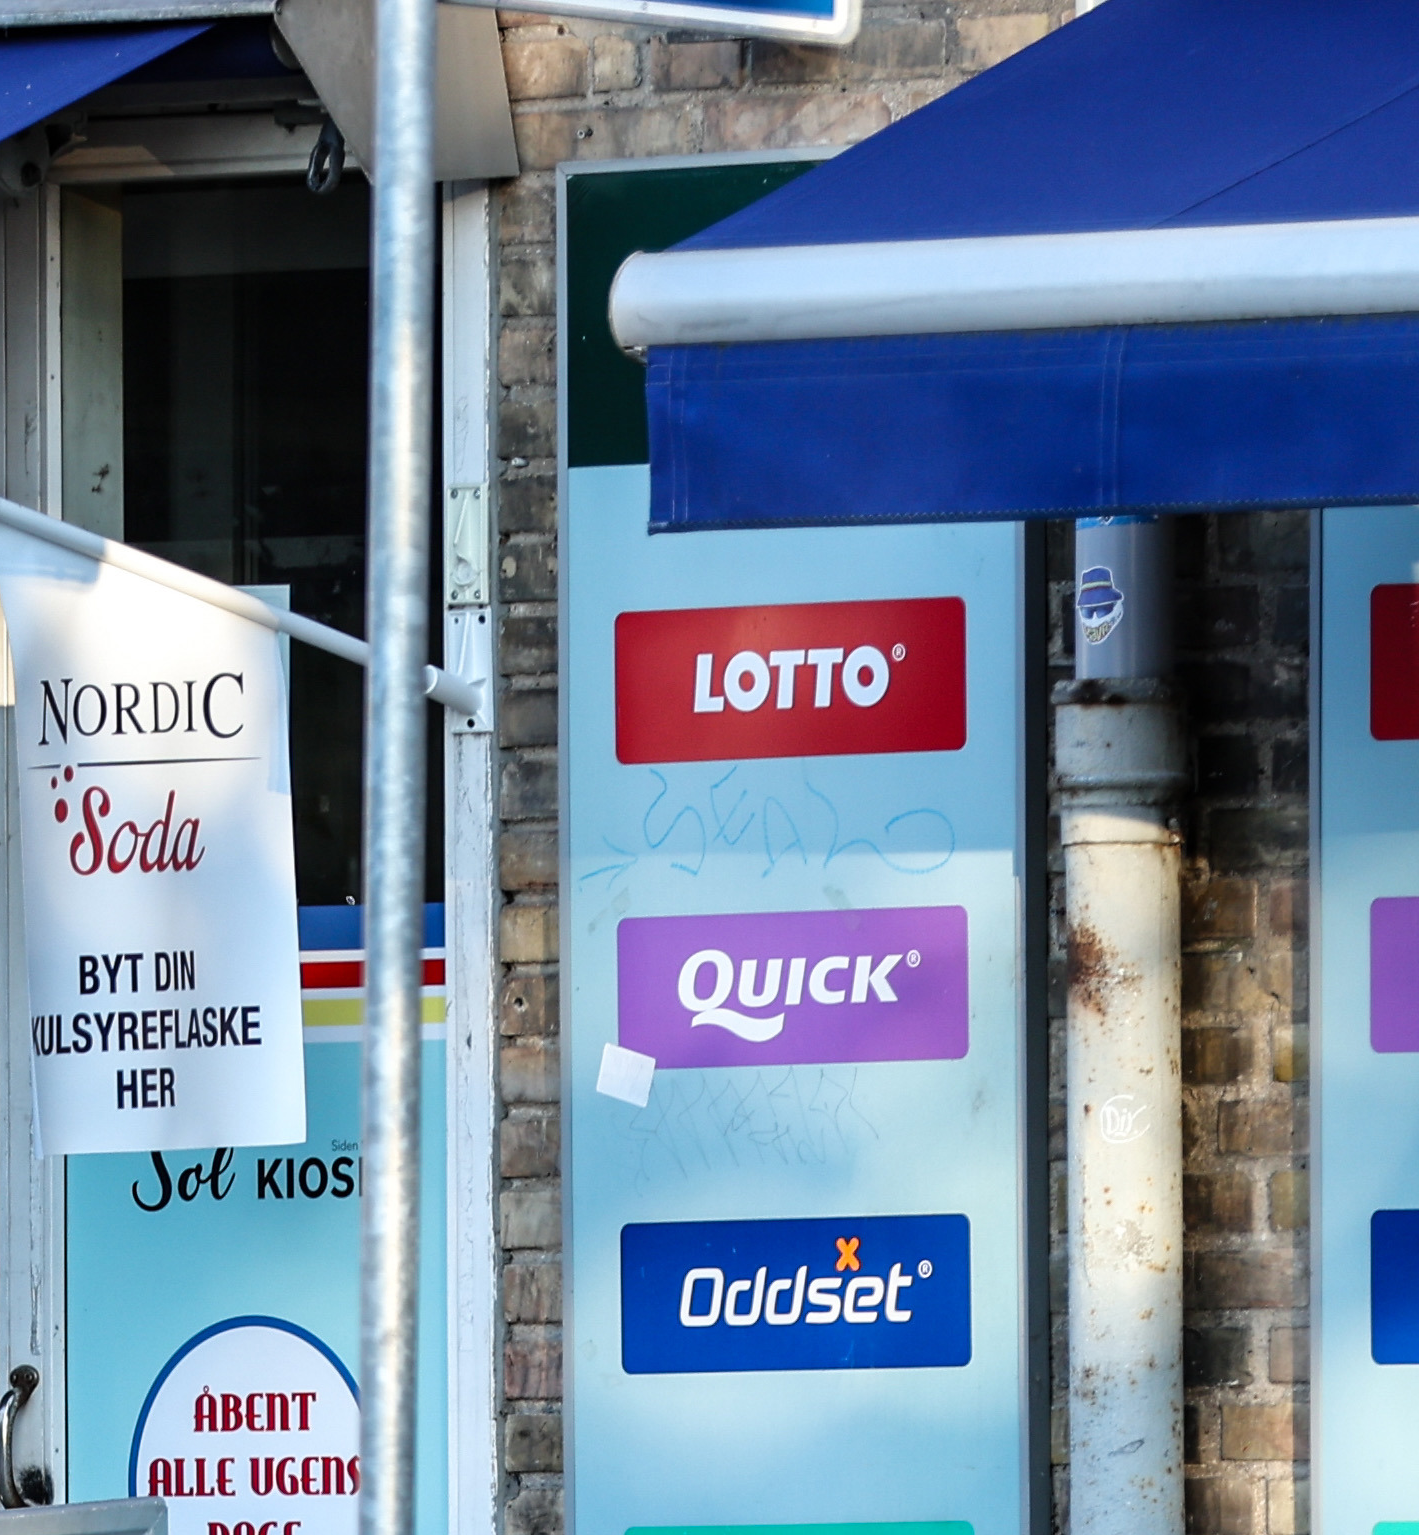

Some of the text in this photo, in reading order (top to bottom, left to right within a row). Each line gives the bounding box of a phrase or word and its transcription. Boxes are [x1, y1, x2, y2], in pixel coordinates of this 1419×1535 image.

[692, 645, 890, 714] LOTTO
[38, 672, 244, 746] NORDIC
[69, 785, 206, 876] Soda
[78, 950, 196, 995] BYT DIN
[31, 1005, 262, 1057] KULSYREFLASKE
[116, 1067, 176, 1110] HER
[331, 1139, 359, 1152] Siden
[257, 1156, 362, 1199] KIOS
[678, 1262, 913, 1330] Oddset
[193, 1384, 317, 1433] ÅBENT
[147, 1453, 361, 1497] ALLE UGENS
